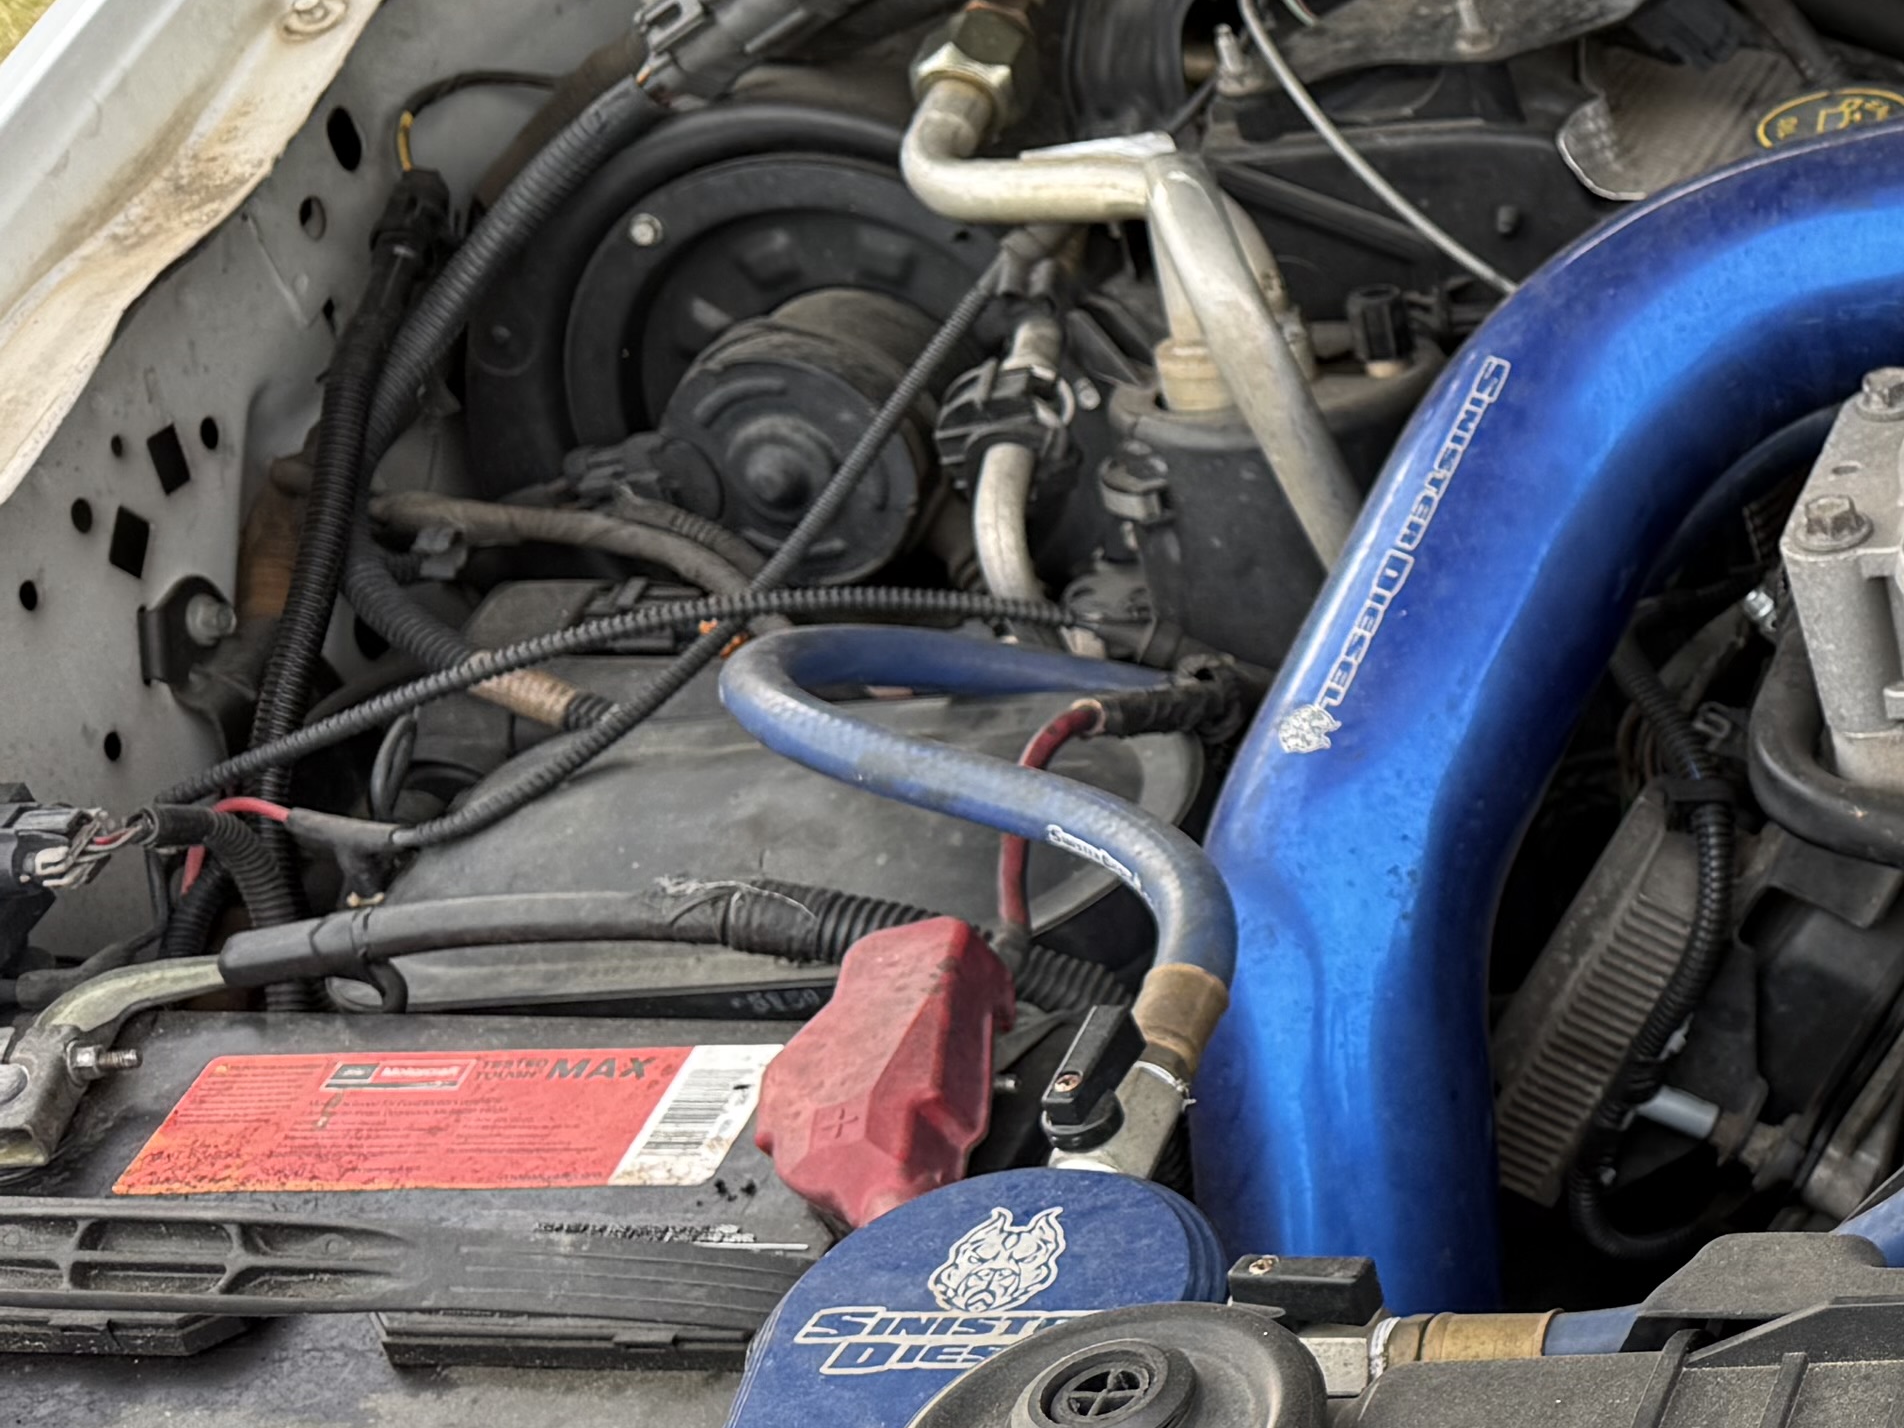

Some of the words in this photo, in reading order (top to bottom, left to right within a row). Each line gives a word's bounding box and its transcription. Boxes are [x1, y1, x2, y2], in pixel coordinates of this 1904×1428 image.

[1397, 355, 1511, 551] SINISTER
[1317, 548, 1414, 708] DIESEL
[547, 1056, 656, 1080] MAX
[795, 1306, 1085, 1345] SINIST
[820, 1343, 1000, 1376] DIES
